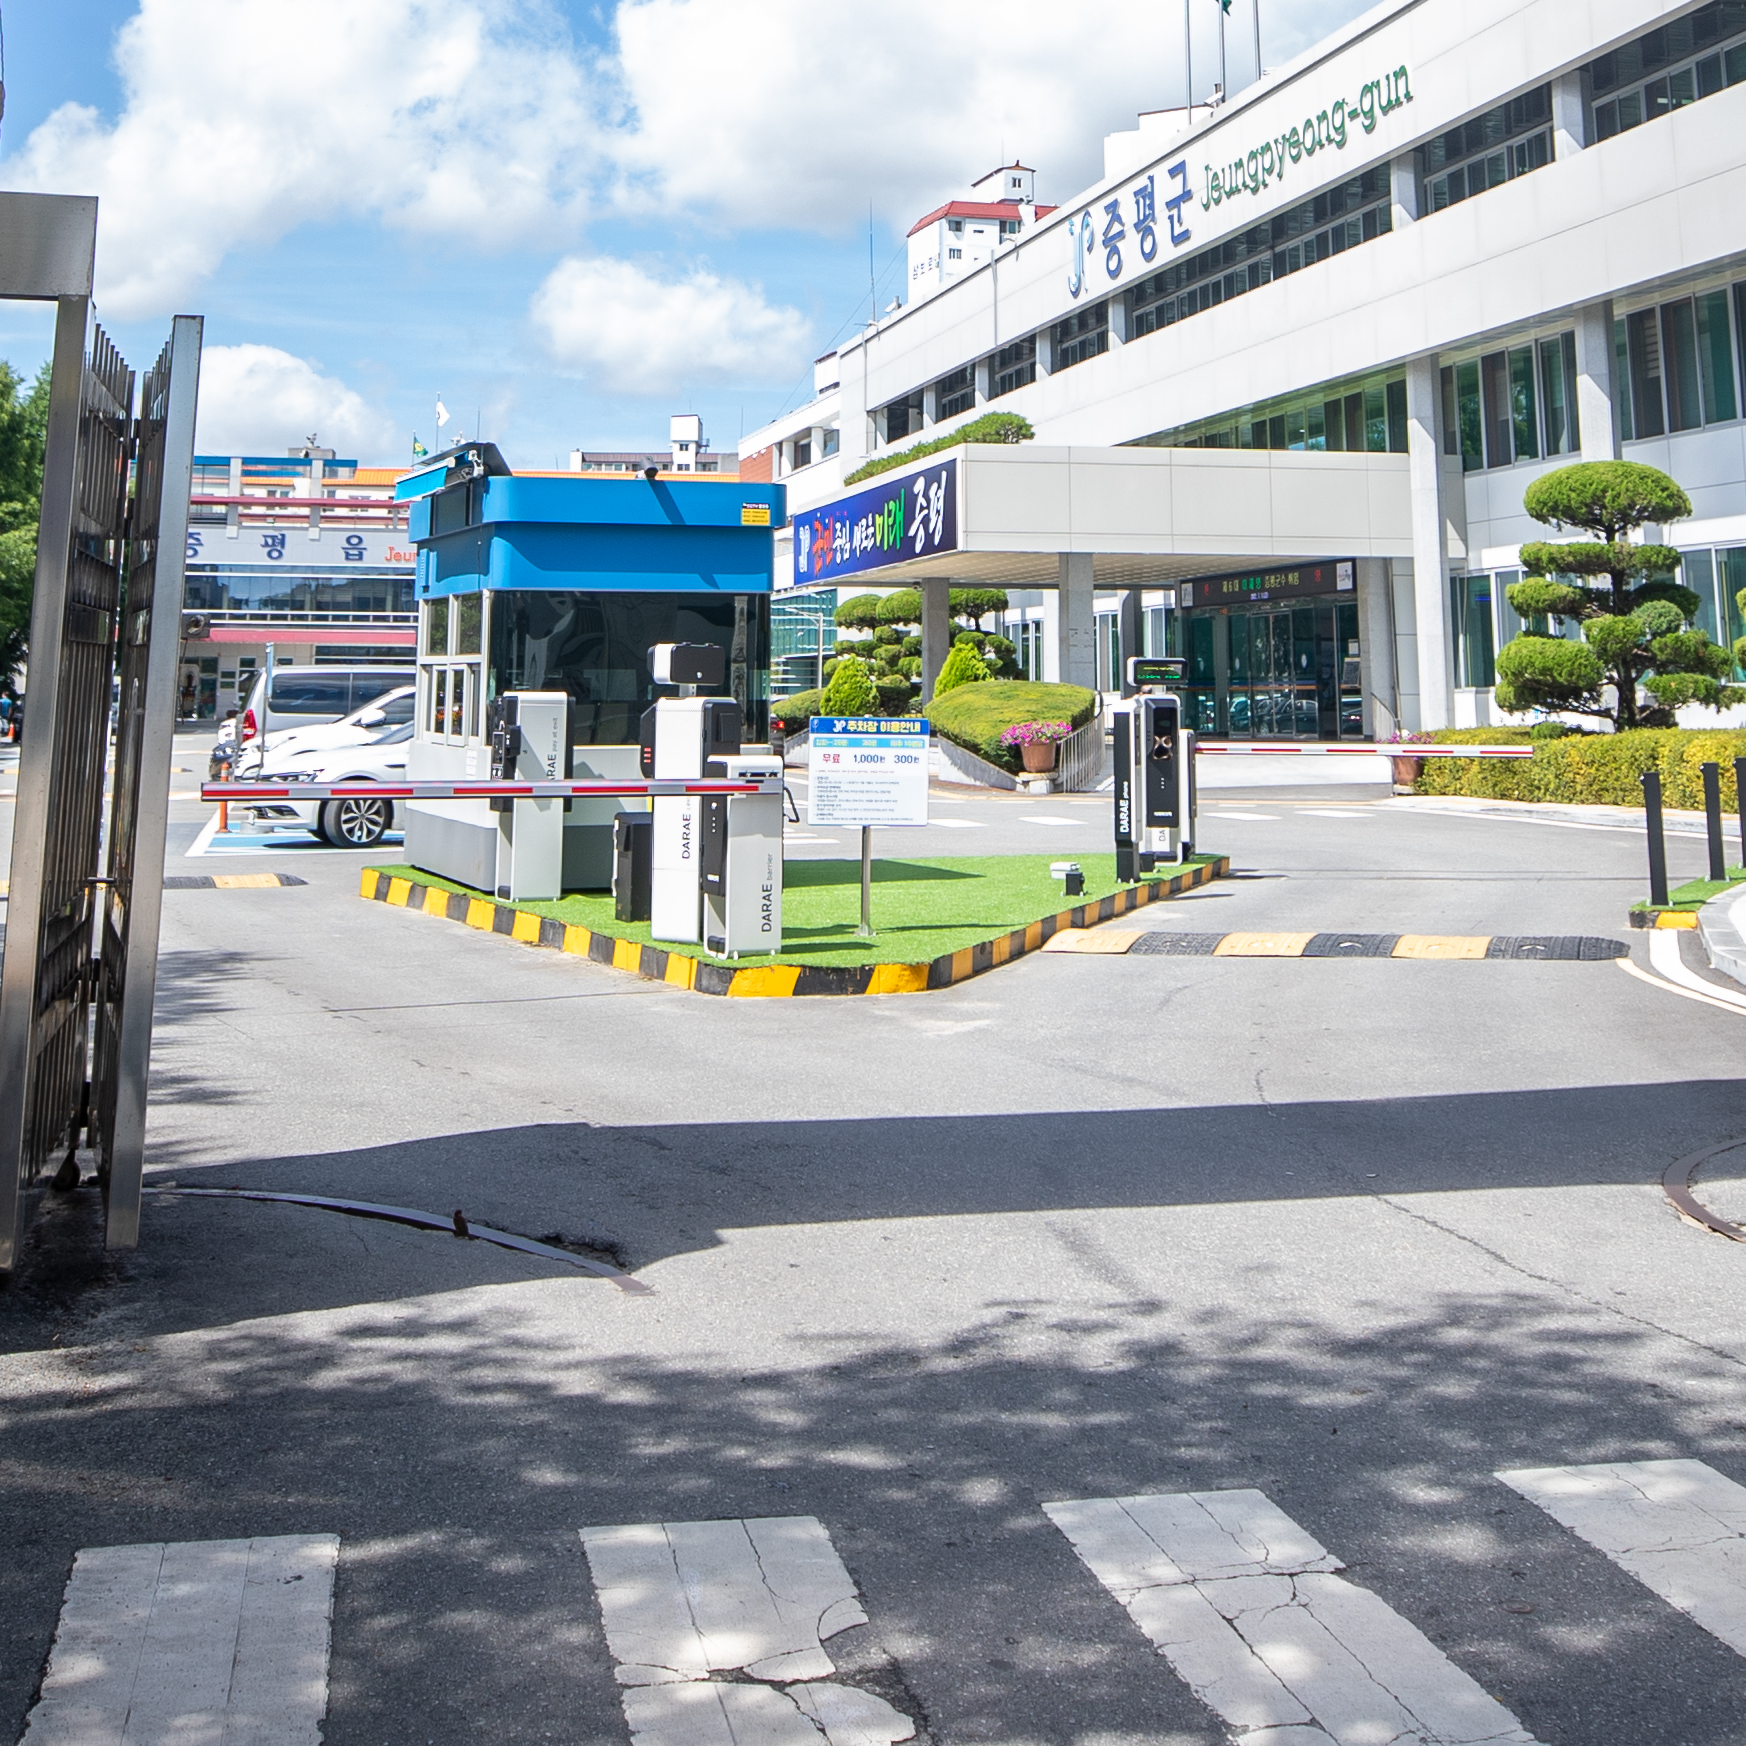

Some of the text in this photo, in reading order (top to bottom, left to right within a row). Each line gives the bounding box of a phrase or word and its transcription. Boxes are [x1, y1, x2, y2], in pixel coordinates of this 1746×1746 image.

[1200, 63, 1414, 211] Jeungpyeong-gun
[1102, 160, 1193, 280] 증평군
[875, 488, 905, 552] 미래
[907, 470, 948, 554] 증평
[682, 813, 691, 859] DARAE
[1119, 799, 1130, 833] DARAE
[762, 883, 773, 932] DARAE
